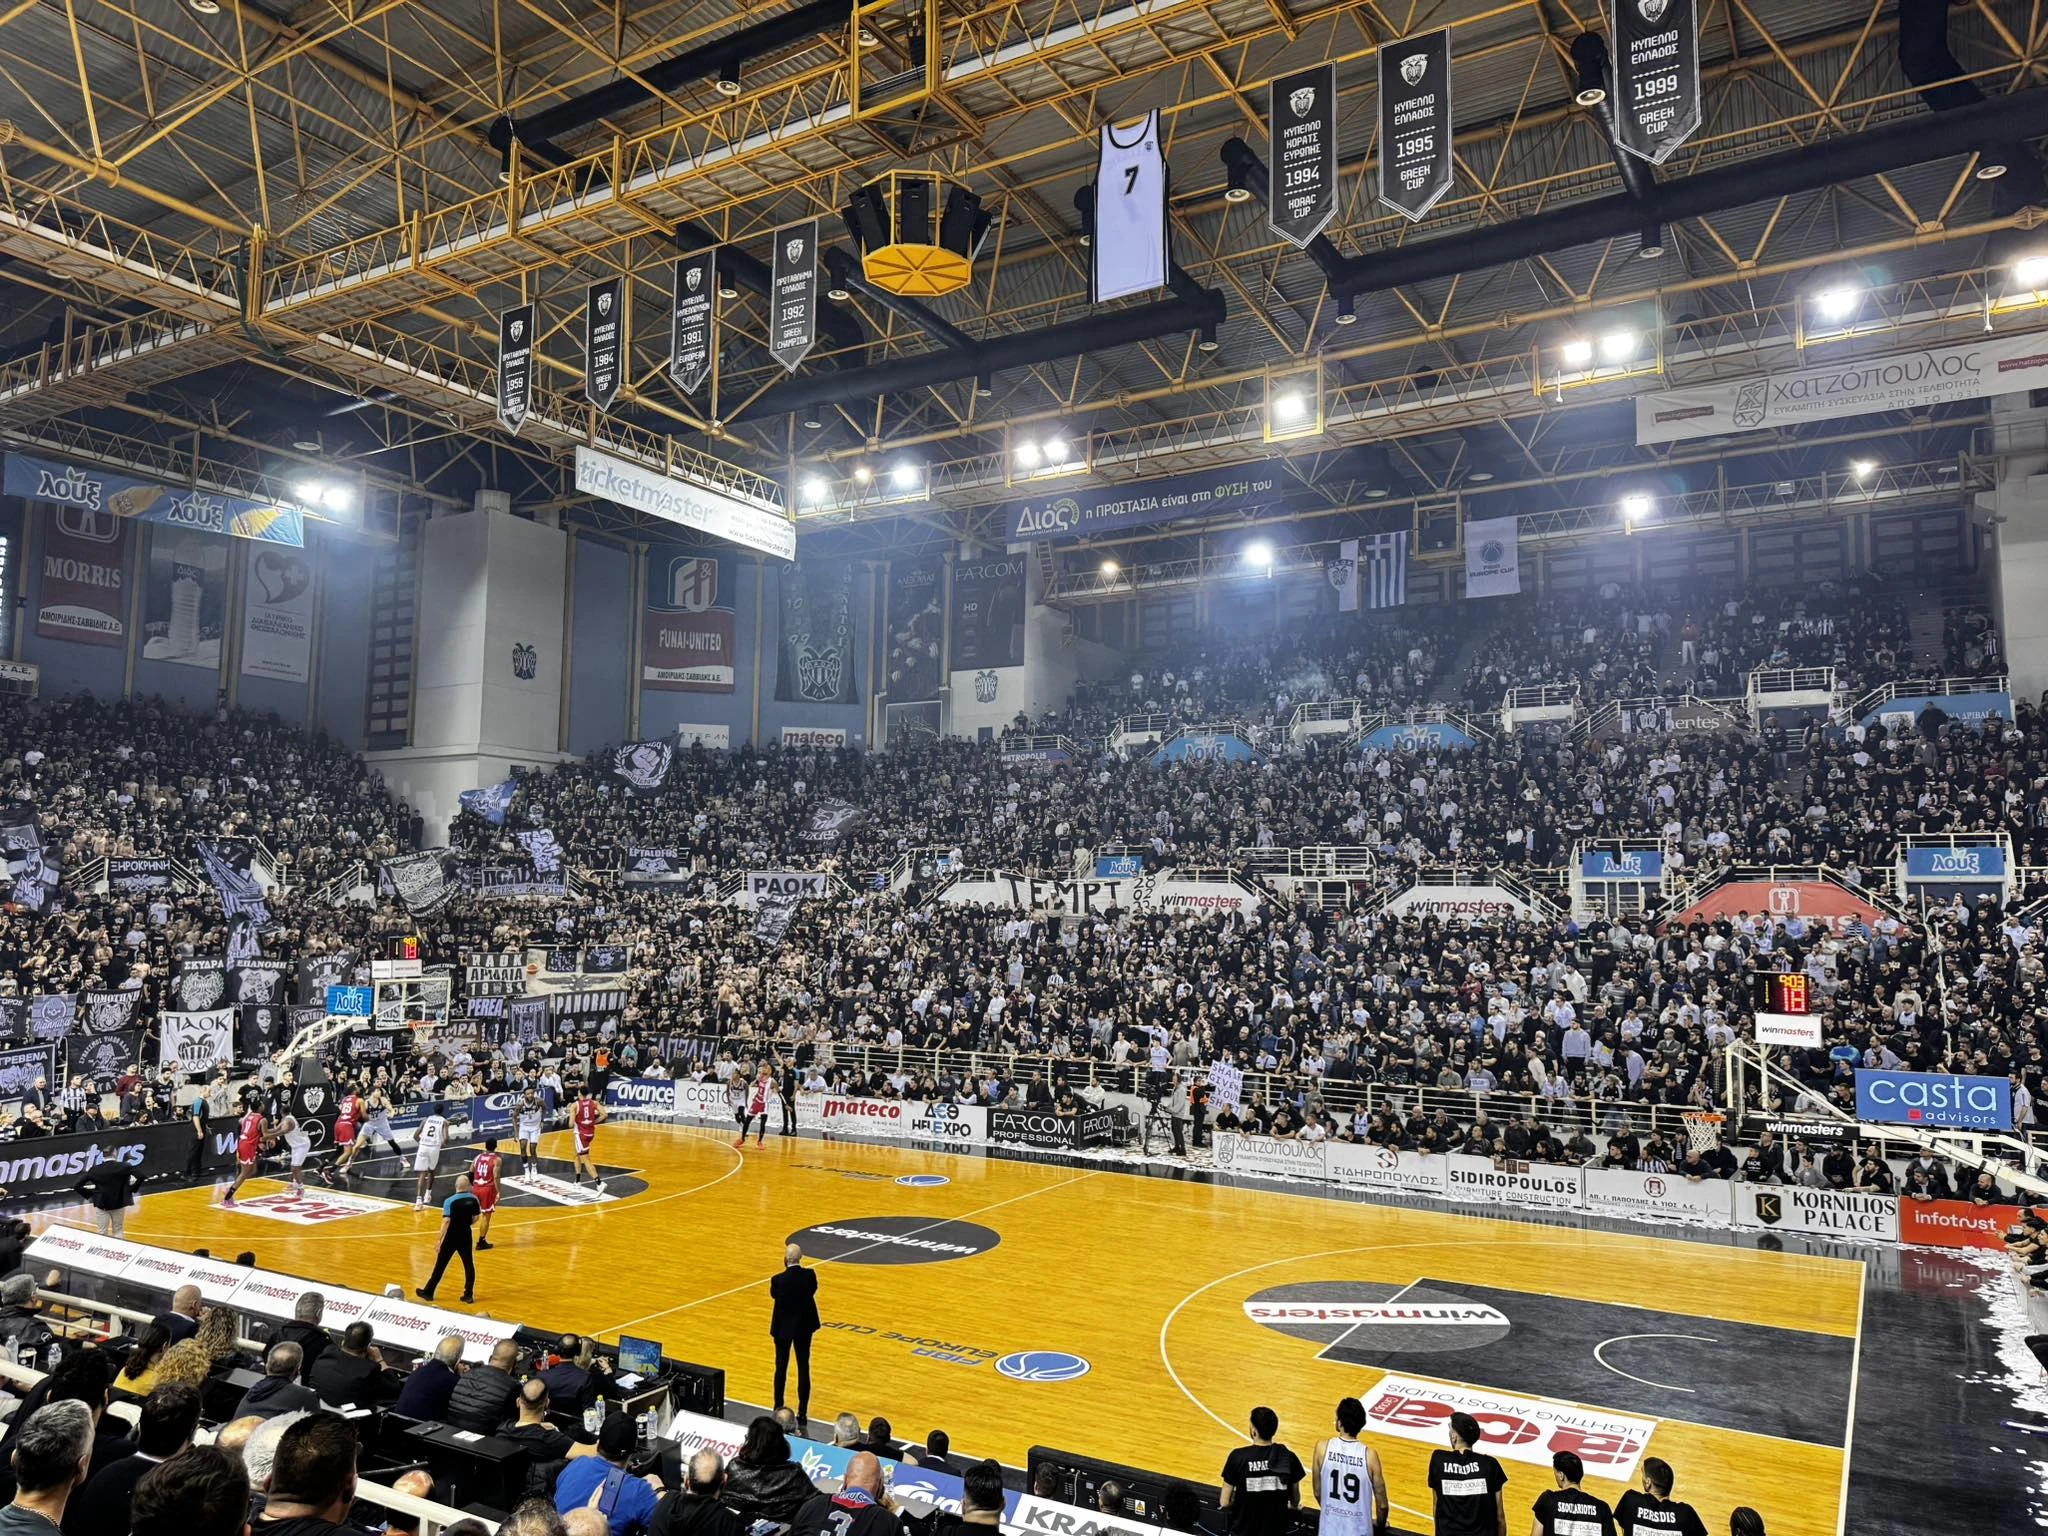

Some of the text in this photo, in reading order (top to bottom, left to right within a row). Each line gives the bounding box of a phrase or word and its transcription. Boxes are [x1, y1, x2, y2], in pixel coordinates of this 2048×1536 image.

[1634, 74, 1678, 101] 1999
[1639, 106, 1675, 125] GREEK
[1646, 121, 1668, 135] CUP
[1397, 135, 1433, 158] 1995
[1124, 164, 1139, 196] 7
[1285, 165, 1320, 187] 1994
[1400, 165, 1431, 181] GREEK
[1406, 177, 1425, 191] CUP
[1288, 194, 1317, 210] KORAC
[1294, 207, 1311, 219] CUP
[781, 305, 804, 321] 1992
[682, 331, 703, 345] 1991
[783, 327, 802, 339] GREEK
[777, 335, 808, 350] CHAMPION
[594, 352, 614, 367] 1984
[686, 361, 697, 371] CUP
[506, 376, 523, 392] 1959
[595, 373, 612, 385] GREEK
[598, 382, 609, 392] CUP
[1888, 387, 1915, 398] ΣΤΗΝ
[1918, 377, 1981, 393] ΤΕΛΕΙΟΤΗΤΑ
[580, 460, 714, 523] ticketmaster
[1096, 499, 1159, 518] ΠΡΟΣΤΑΣΙΑ
[1161, 494, 1188, 507] είναι
[1192, 492, 1211, 503] στη
[1214, 481, 1249, 499] ΦΥΣΗ
[1252, 479, 1272, 493] του
[45, 556, 122, 589] MORRIS
[955, 561, 1023, 581] FARCOM
[659, 628, 722, 651] FUNAI-UNITED
[754, 878, 819, 894] PAOK
[1161, 893, 1242, 908] winmasters
[1779, 975, 1805, 988] 9:03
[556, 991, 626, 1015] PANORAMA
[166, 1014, 229, 1034] ΠΑΟΚ
[1762, 1026, 1814, 1037] winmasters
[617, 1084, 675, 1102] avance
[1869, 1076, 1997, 1112] casta
[823, 1100, 901, 1118] mateco
[1925, 1110, 1996, 1125] advisors
[428, 1126, 436, 1138] 2
[993, 1112, 1075, 1135] FARCOM
[1766, 1121, 1844, 1136] winmasters
[993, 1130, 1075, 1145] PROFESSIONAL
[1334, 1166, 1439, 1186] ΣΙΔΗΡΟΠΟΥΛΟΣ
[1450, 1170, 1577, 1194] SIDIROPOULOS
[1506, 1191, 1571, 1204] CONSTRUCTION
[1793, 1191, 1896, 1216] KORNILIOS
[1805, 1211, 1886, 1233] PALACE
[1915, 1210, 1997, 1231] infotrust
[40, 1235, 85, 1251] winmasters
[86, 1244, 133, 1263] winmasters
[135, 1255, 184, 1275] winmasters
[187, 1267, 240, 1287] winmasters
[244, 1280, 299, 1301] winmasters
[368, 1308, 431, 1332] winmasters
[1251, 1305, 1502, 1322] winmasters
[1386, 1384, 1647, 1437] LIGHTING APOSTOLIDIS
[1329, 1469, 1361, 1504] 19
